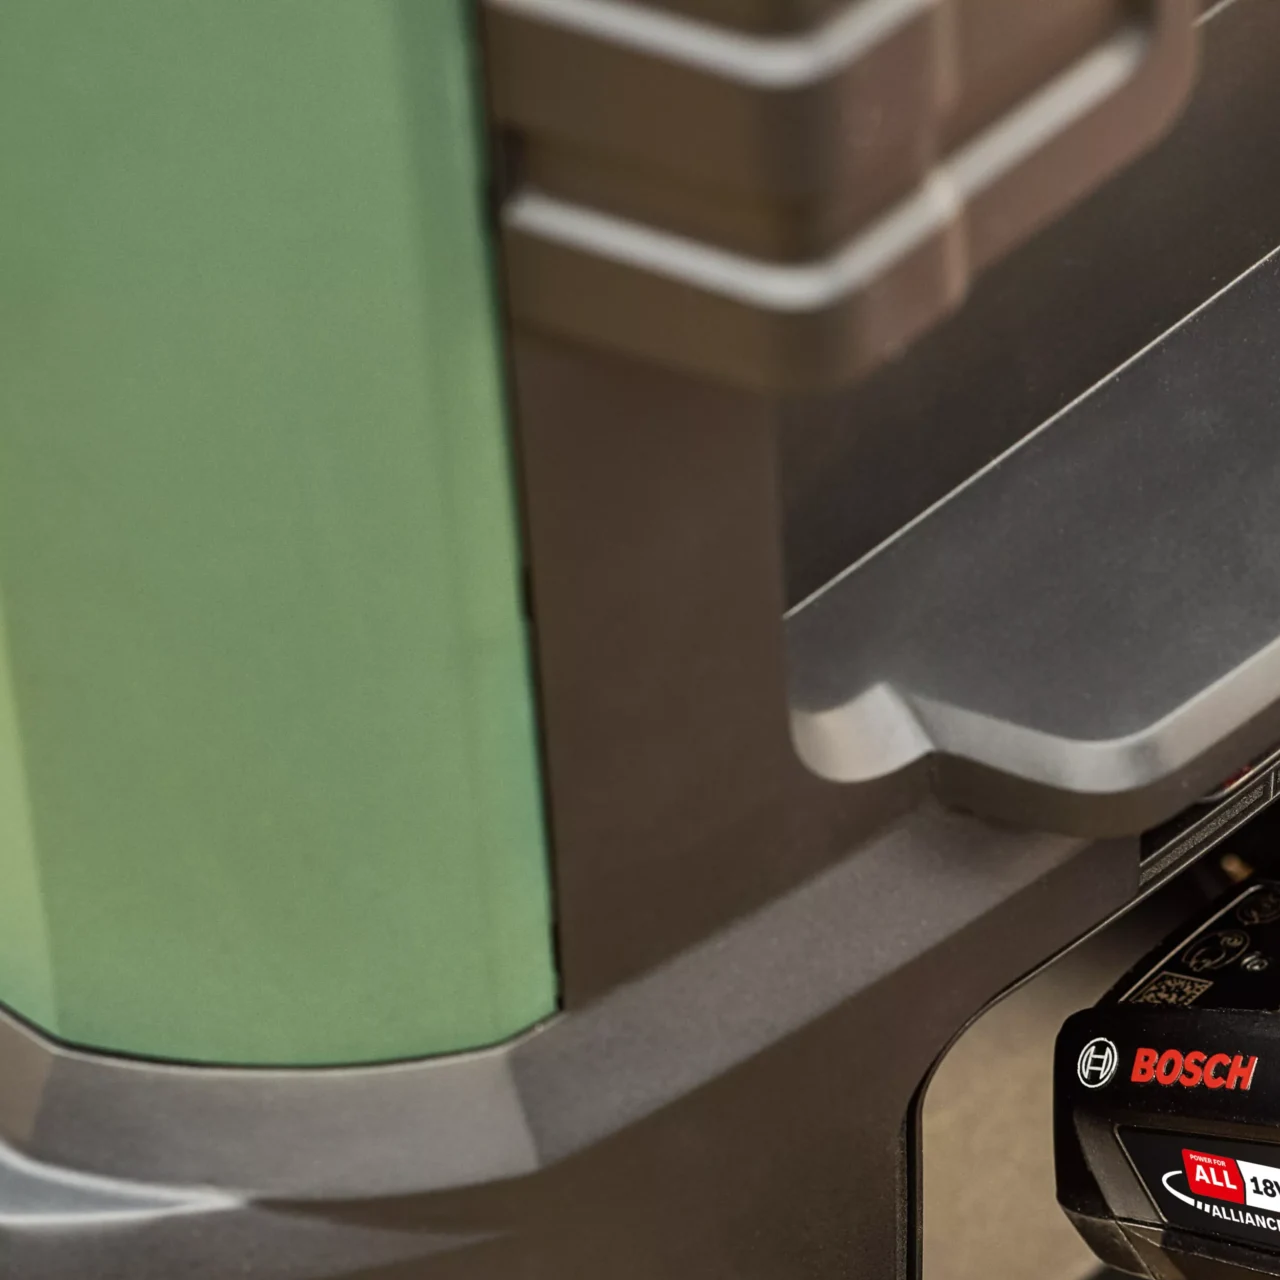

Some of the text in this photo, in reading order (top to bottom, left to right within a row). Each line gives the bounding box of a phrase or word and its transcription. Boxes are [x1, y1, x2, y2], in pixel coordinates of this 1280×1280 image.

[1131, 1048, 1258, 1090] BOSCH
[1190, 1153, 1227, 1168] POWER FOR
[1195, 1164, 1238, 1190] ALL
